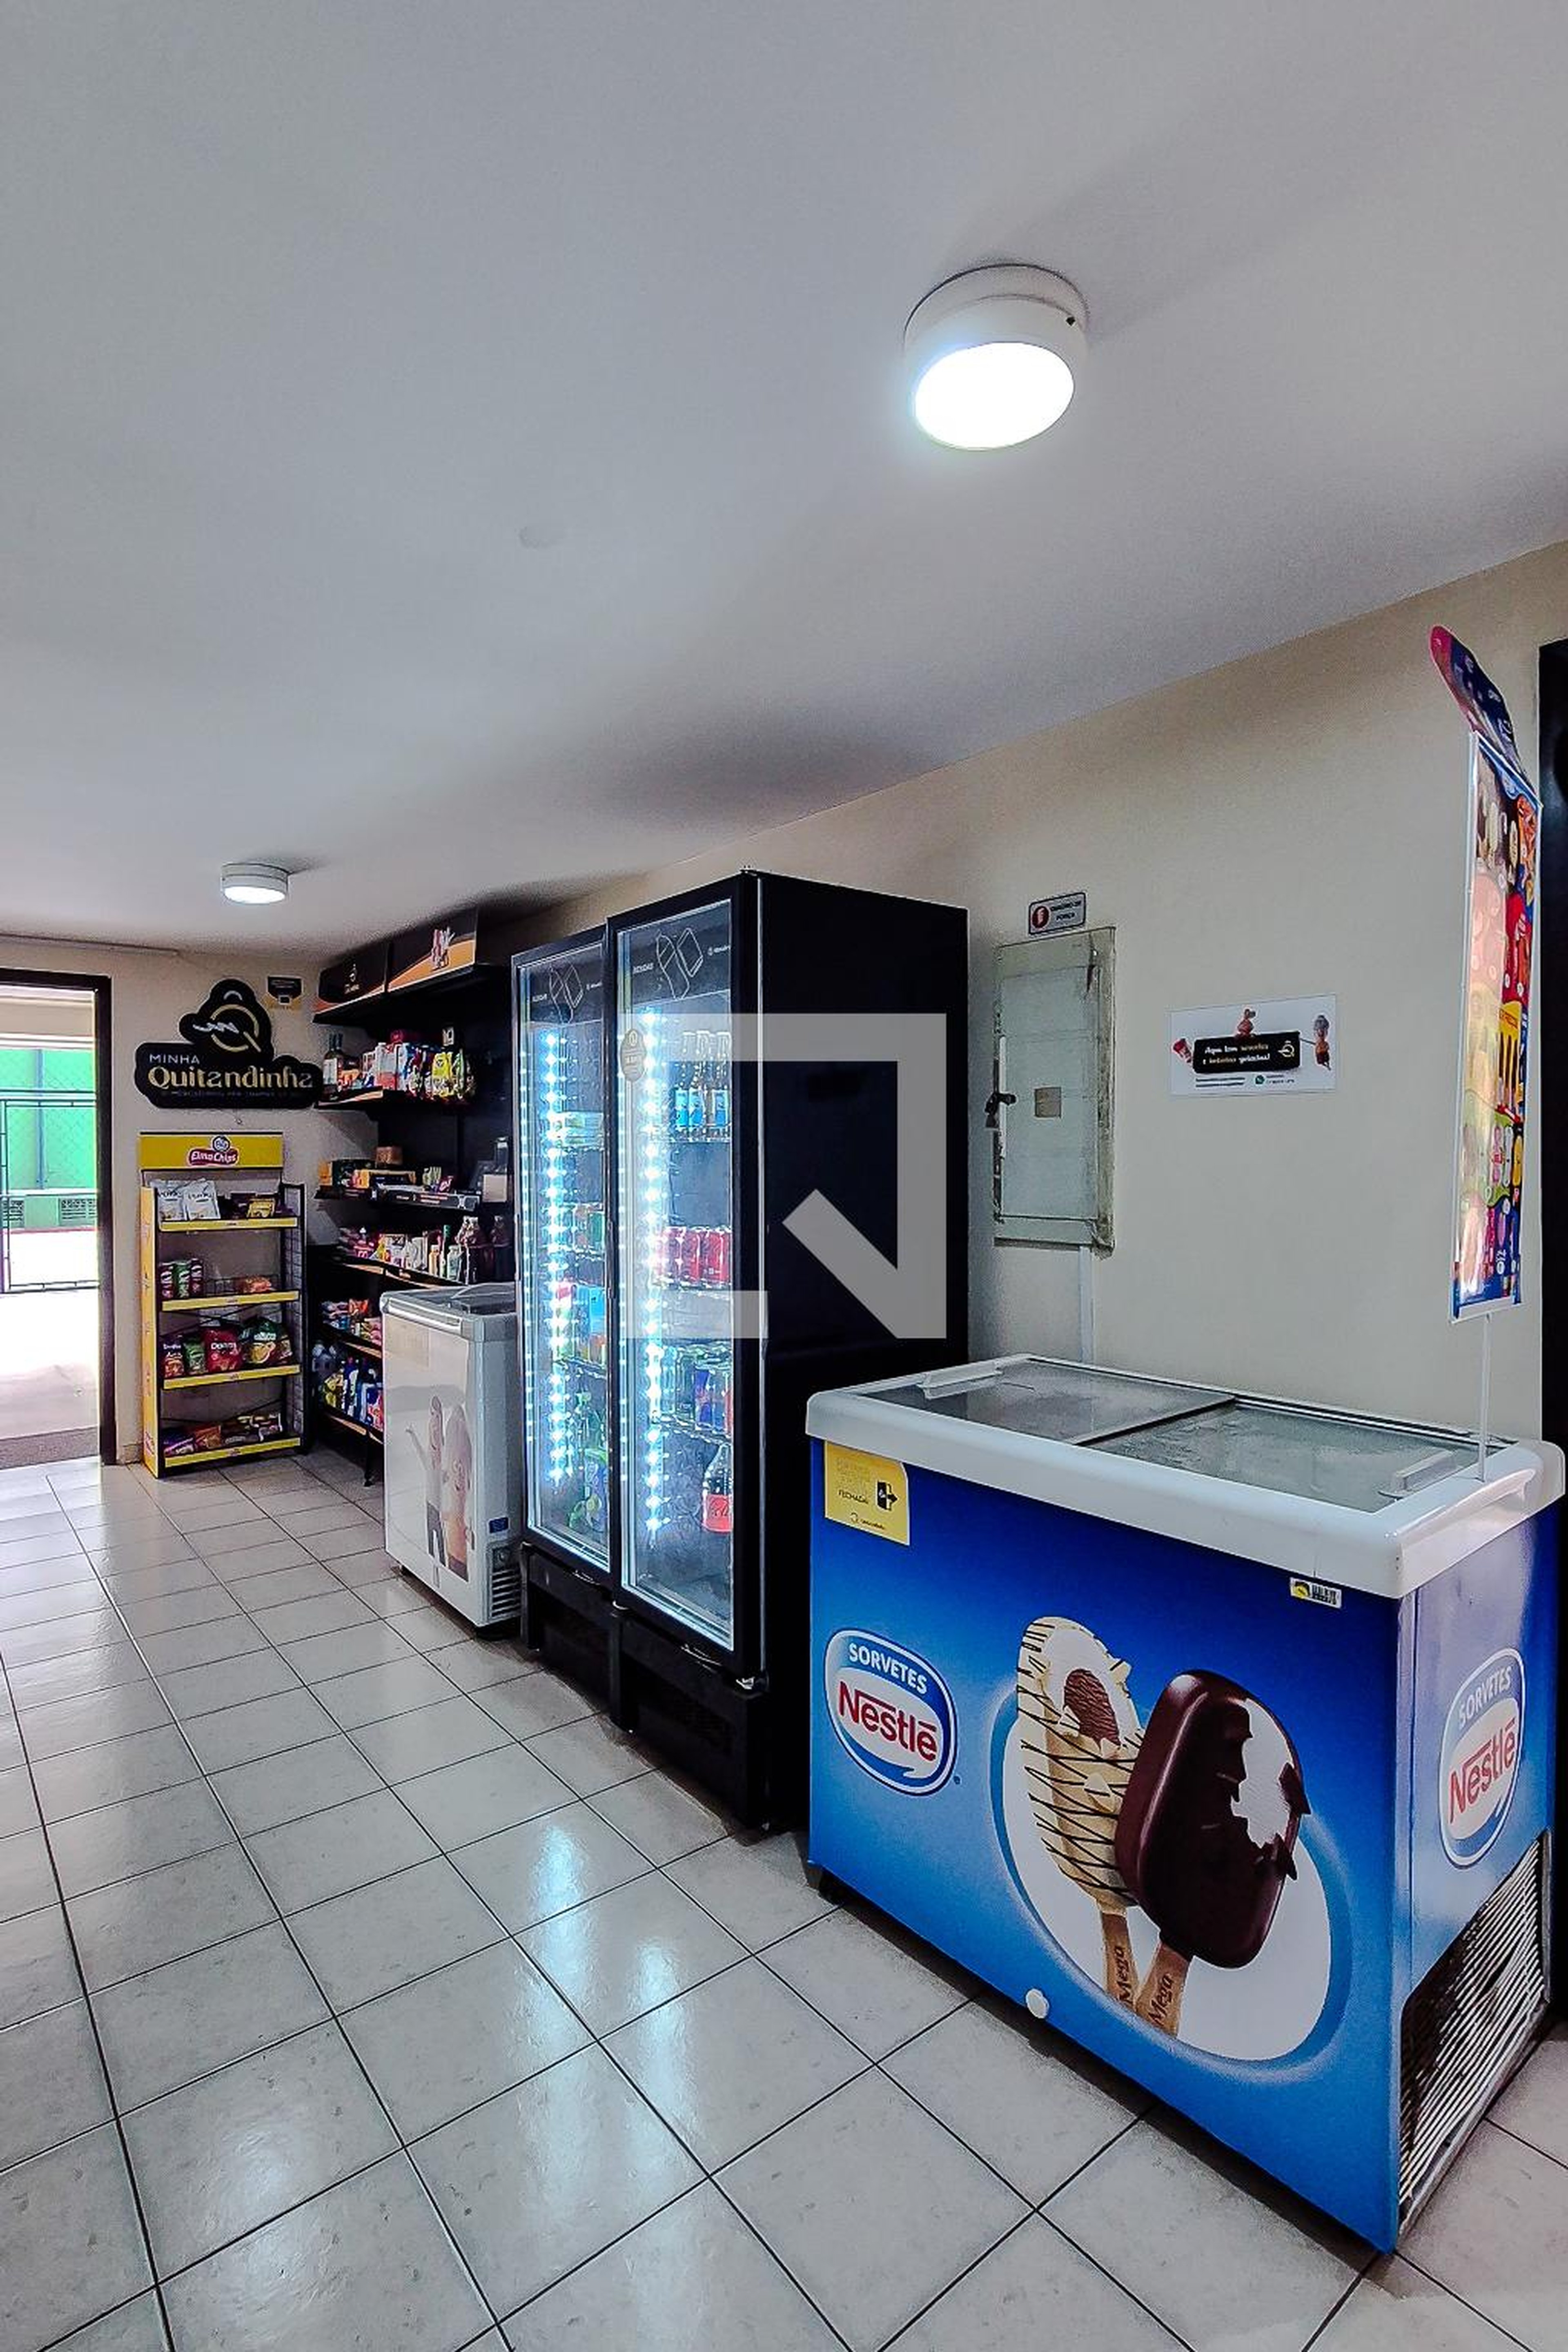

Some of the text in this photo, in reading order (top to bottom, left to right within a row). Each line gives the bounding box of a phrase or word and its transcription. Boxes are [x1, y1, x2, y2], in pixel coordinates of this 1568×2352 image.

[147, 1065, 313, 1089] Quitandinha
[149, 1054, 200, 1065] MINHA
[849, 1642, 927, 1694] SORVETES
[1459, 1665, 1512, 1730] SORVETES
[1114, 1946, 1134, 2004] Mega
[1148, 1973, 1174, 2026] Mega
